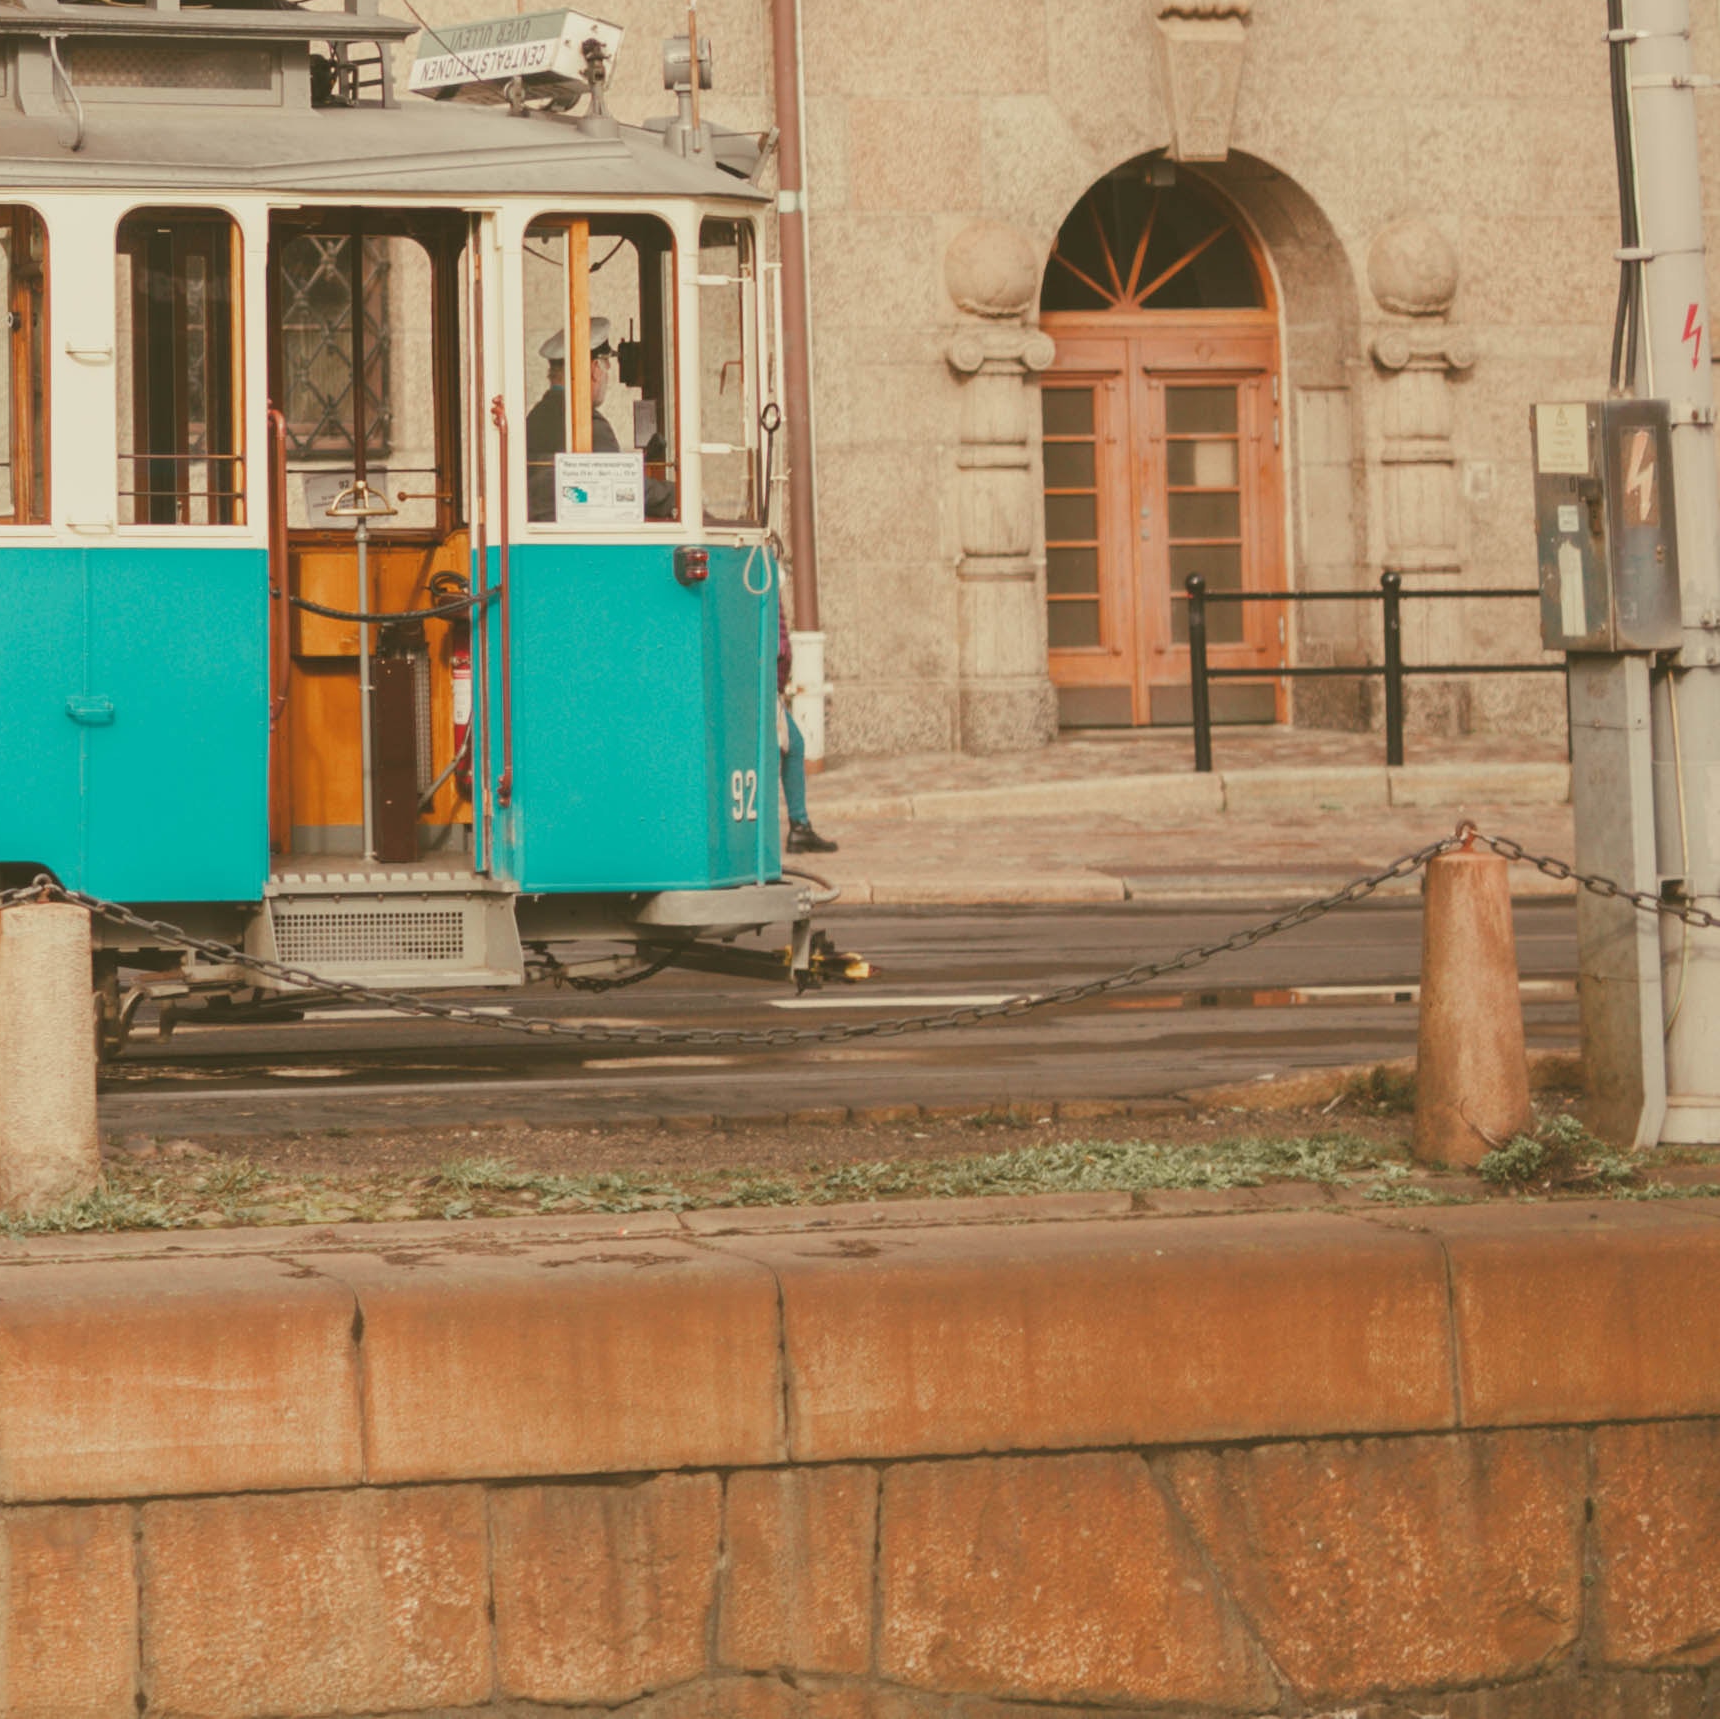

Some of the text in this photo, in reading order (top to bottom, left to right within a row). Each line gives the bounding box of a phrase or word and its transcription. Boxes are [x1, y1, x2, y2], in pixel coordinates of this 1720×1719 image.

[449, 24, 491, 50] ULLEVI
[420, 44, 546, 81] CENTRALSTATIONEN
[731, 769, 758, 822] 92
